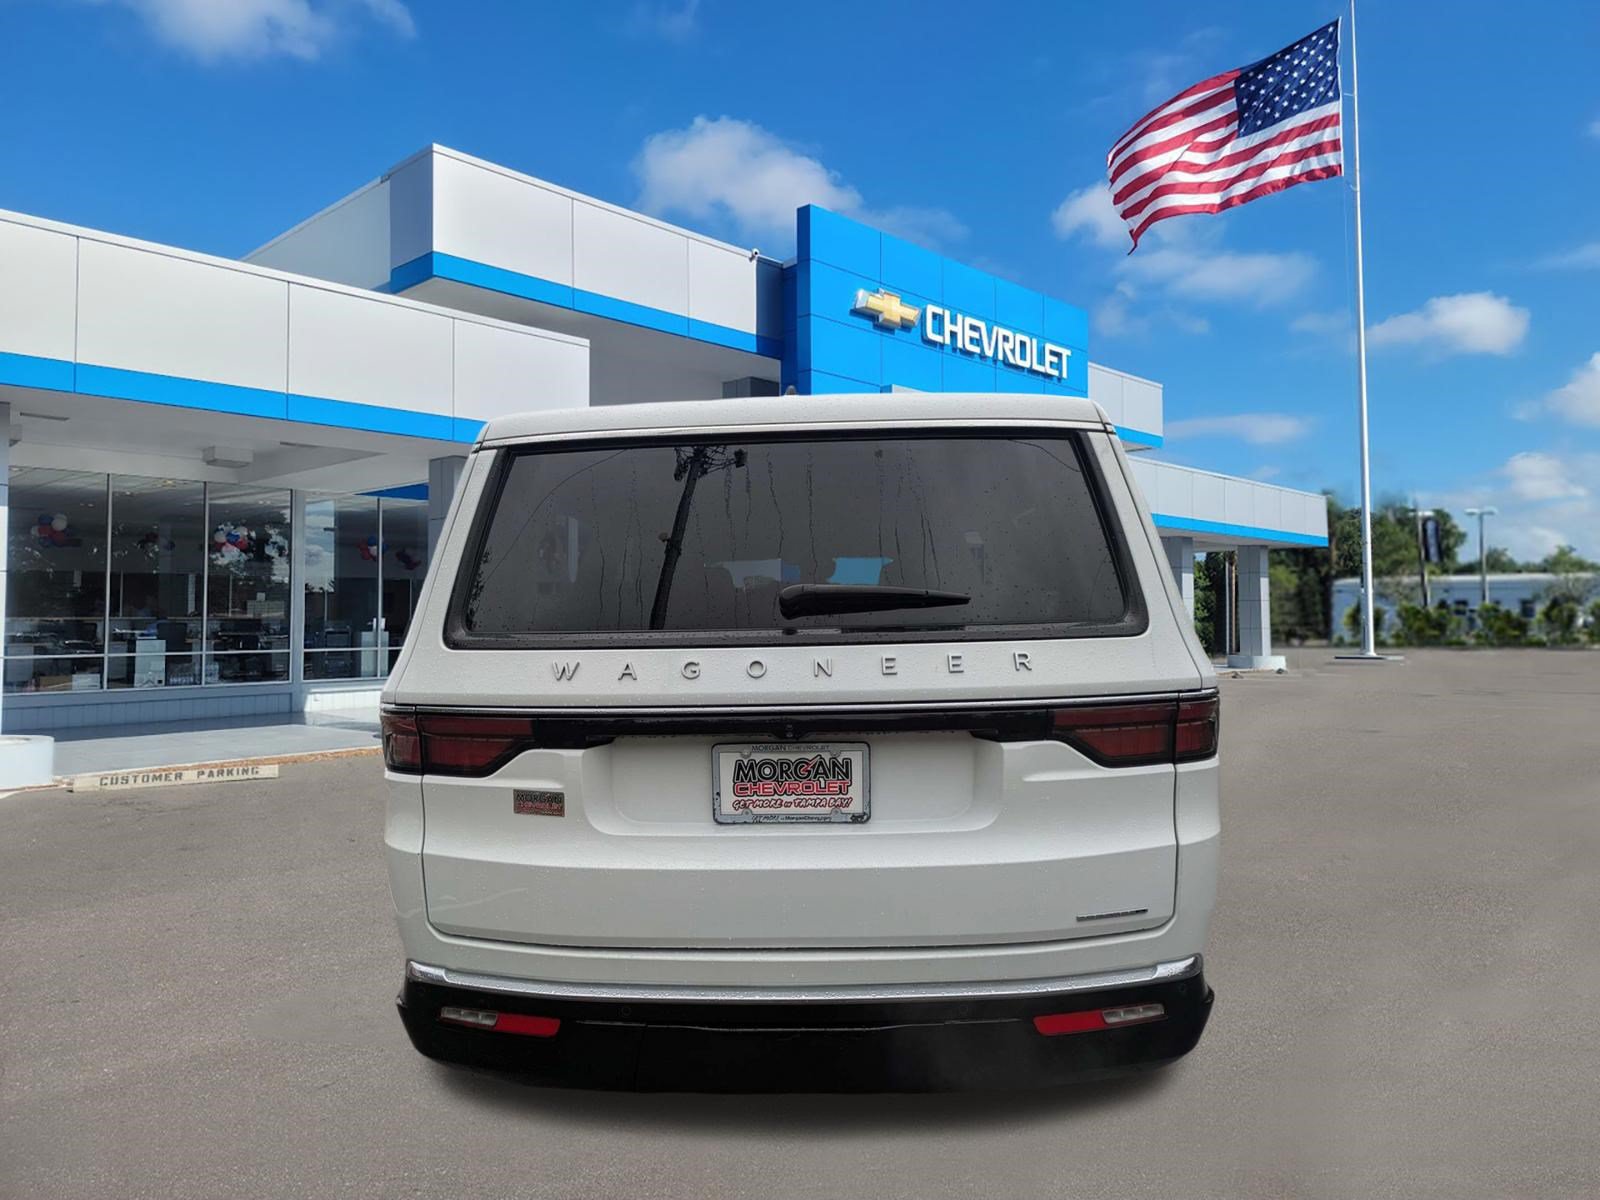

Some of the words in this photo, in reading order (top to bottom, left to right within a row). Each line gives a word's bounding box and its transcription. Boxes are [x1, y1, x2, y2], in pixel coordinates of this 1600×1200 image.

[923, 303, 1072, 380] CHEVROLET
[552, 651, 1033, 682] WAGONEER
[99, 771, 183, 787] CUSTOMER
[196, 766, 260, 779] PARKING
[733, 754, 853, 783] MORGAN
[733, 780, 852, 797] CHEVROLET
[732, 798, 752, 811] GET
[751, 797, 784, 809] MORE
[792, 797, 828, 809] TAMPA
[827, 796, 854, 808] BAY!
